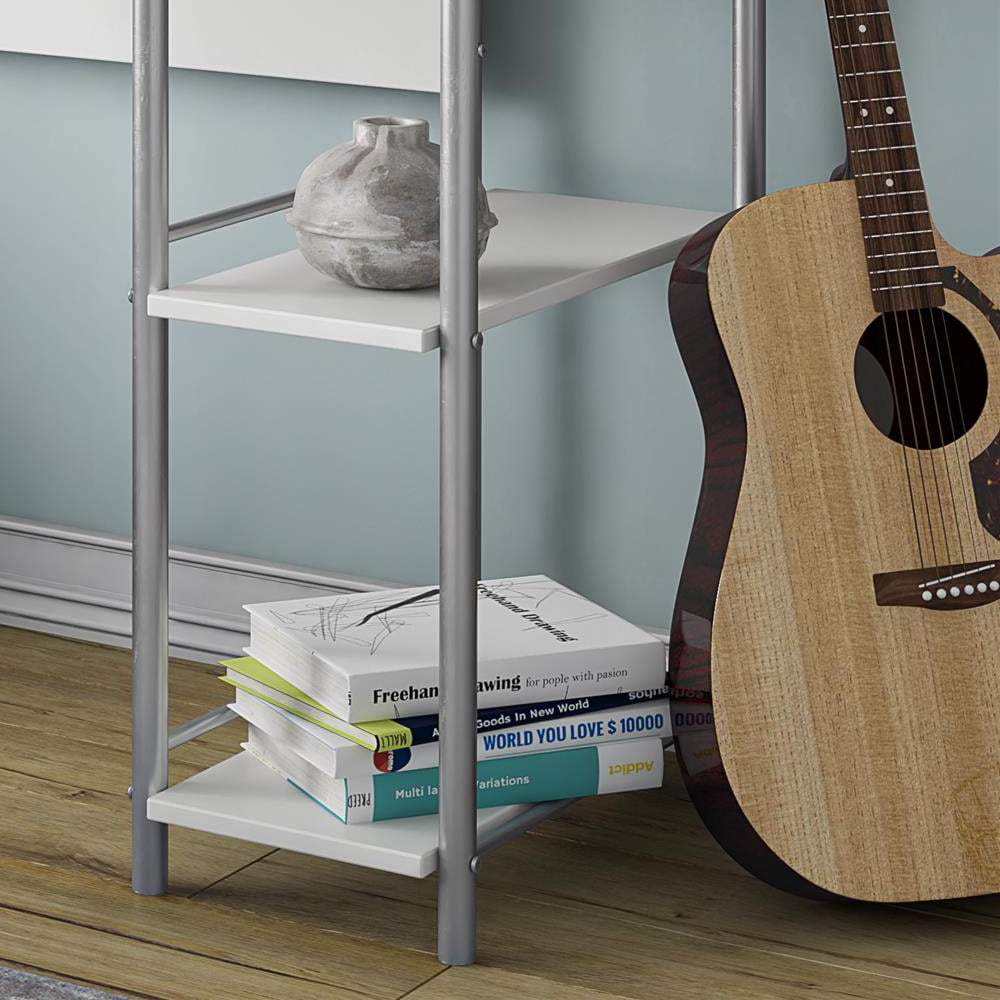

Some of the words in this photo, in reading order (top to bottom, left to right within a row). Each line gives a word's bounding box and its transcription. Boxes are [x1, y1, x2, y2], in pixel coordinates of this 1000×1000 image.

[521, 612, 579, 643] Drawing
[372, 684, 440, 704] Freehan
[477, 674, 521, 694] awing
[525, 676, 541, 690] for
[543, 674, 570, 693] pople
[572, 667, 595, 684] with
[597, 667, 629, 687] pasion
[476, 713, 512, 729] Goods
[515, 709, 526, 722] In
[530, 704, 556, 719] New
[557, 698, 590, 715] World
[483, 731, 534, 752] WORLD
[536, 725, 567, 747] YOU
[569, 720, 604, 741] LOVE
[607, 717, 617, 738] $
[619, 713, 665, 735] 10000
[608, 760, 654, 777] Addict
[394, 785, 425, 802] Multi
[477, 774, 530, 792] ariations
